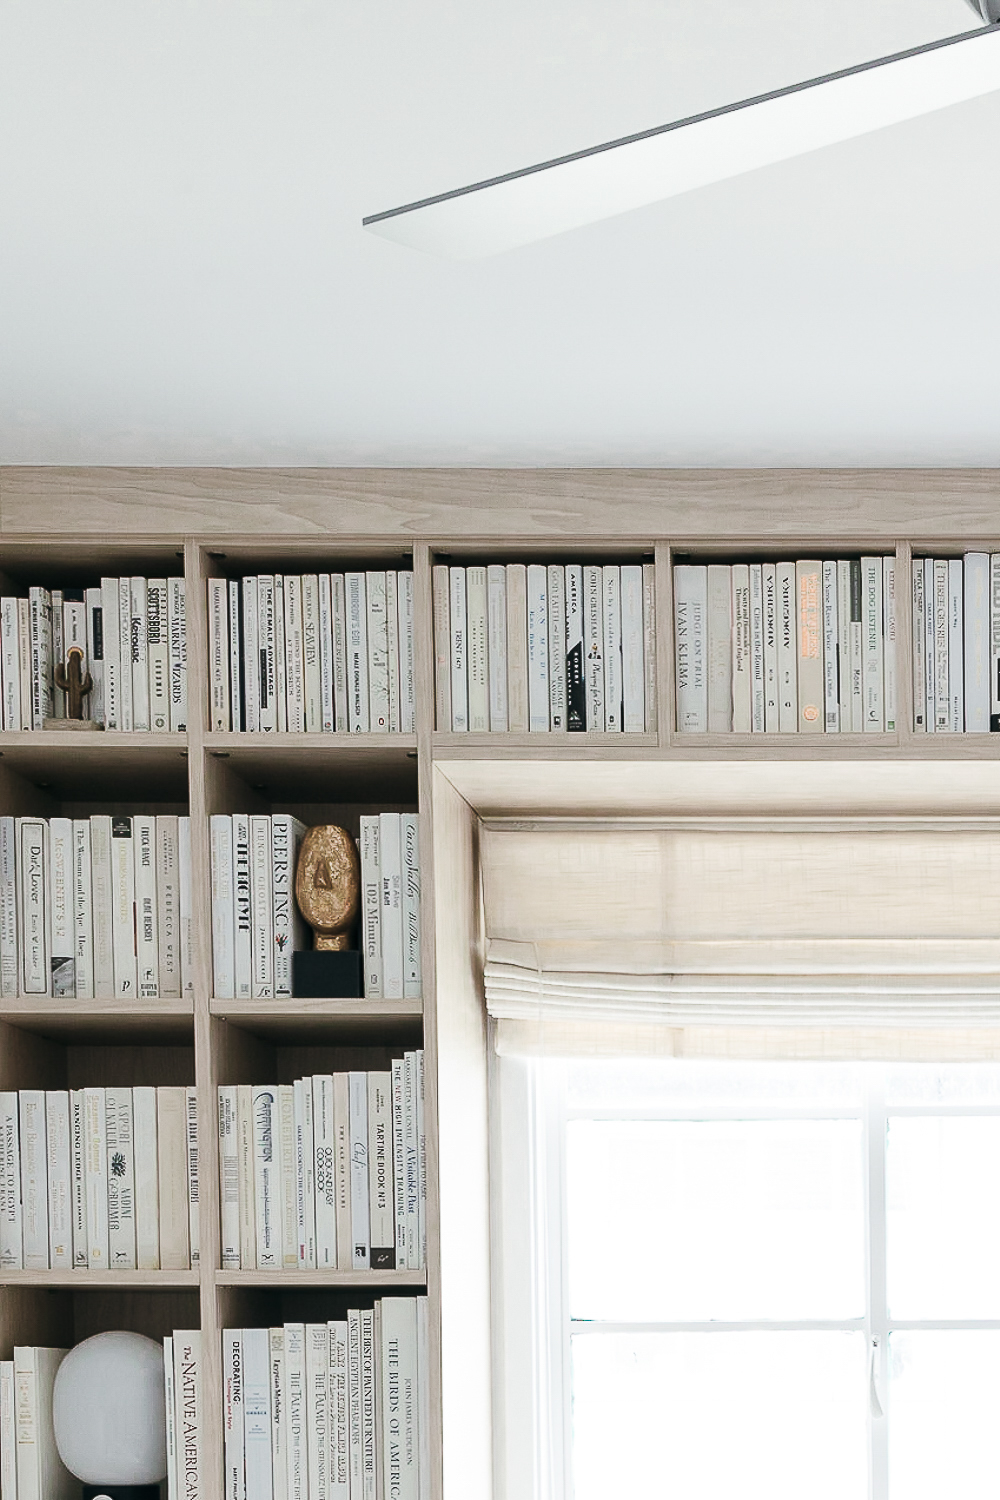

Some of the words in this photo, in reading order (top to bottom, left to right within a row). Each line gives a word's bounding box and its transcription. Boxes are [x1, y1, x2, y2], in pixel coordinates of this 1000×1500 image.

[589, 570, 598, 595] JOHN
[868, 568, 876, 584] THE
[868, 588, 876, 607] DOG
[148, 588, 160, 644] SCOTTSBORO
[590, 598, 598, 639] GRISHAM
[677, 602, 687, 636] IVAN
[171, 617, 181, 659] MARKET
[694, 640, 702, 656] ON
[853, 670, 861, 695] Monet
[274, 823, 288, 884] PEERS
[275, 891, 288, 927] INC
[367, 909, 379, 958] Minutes
[388, 1339, 399, 1367] THE
[182, 1362, 197, 1418] NATIVE
[388, 1373, 400, 1413] BIRDS
[389, 1419, 400, 1437] OF
